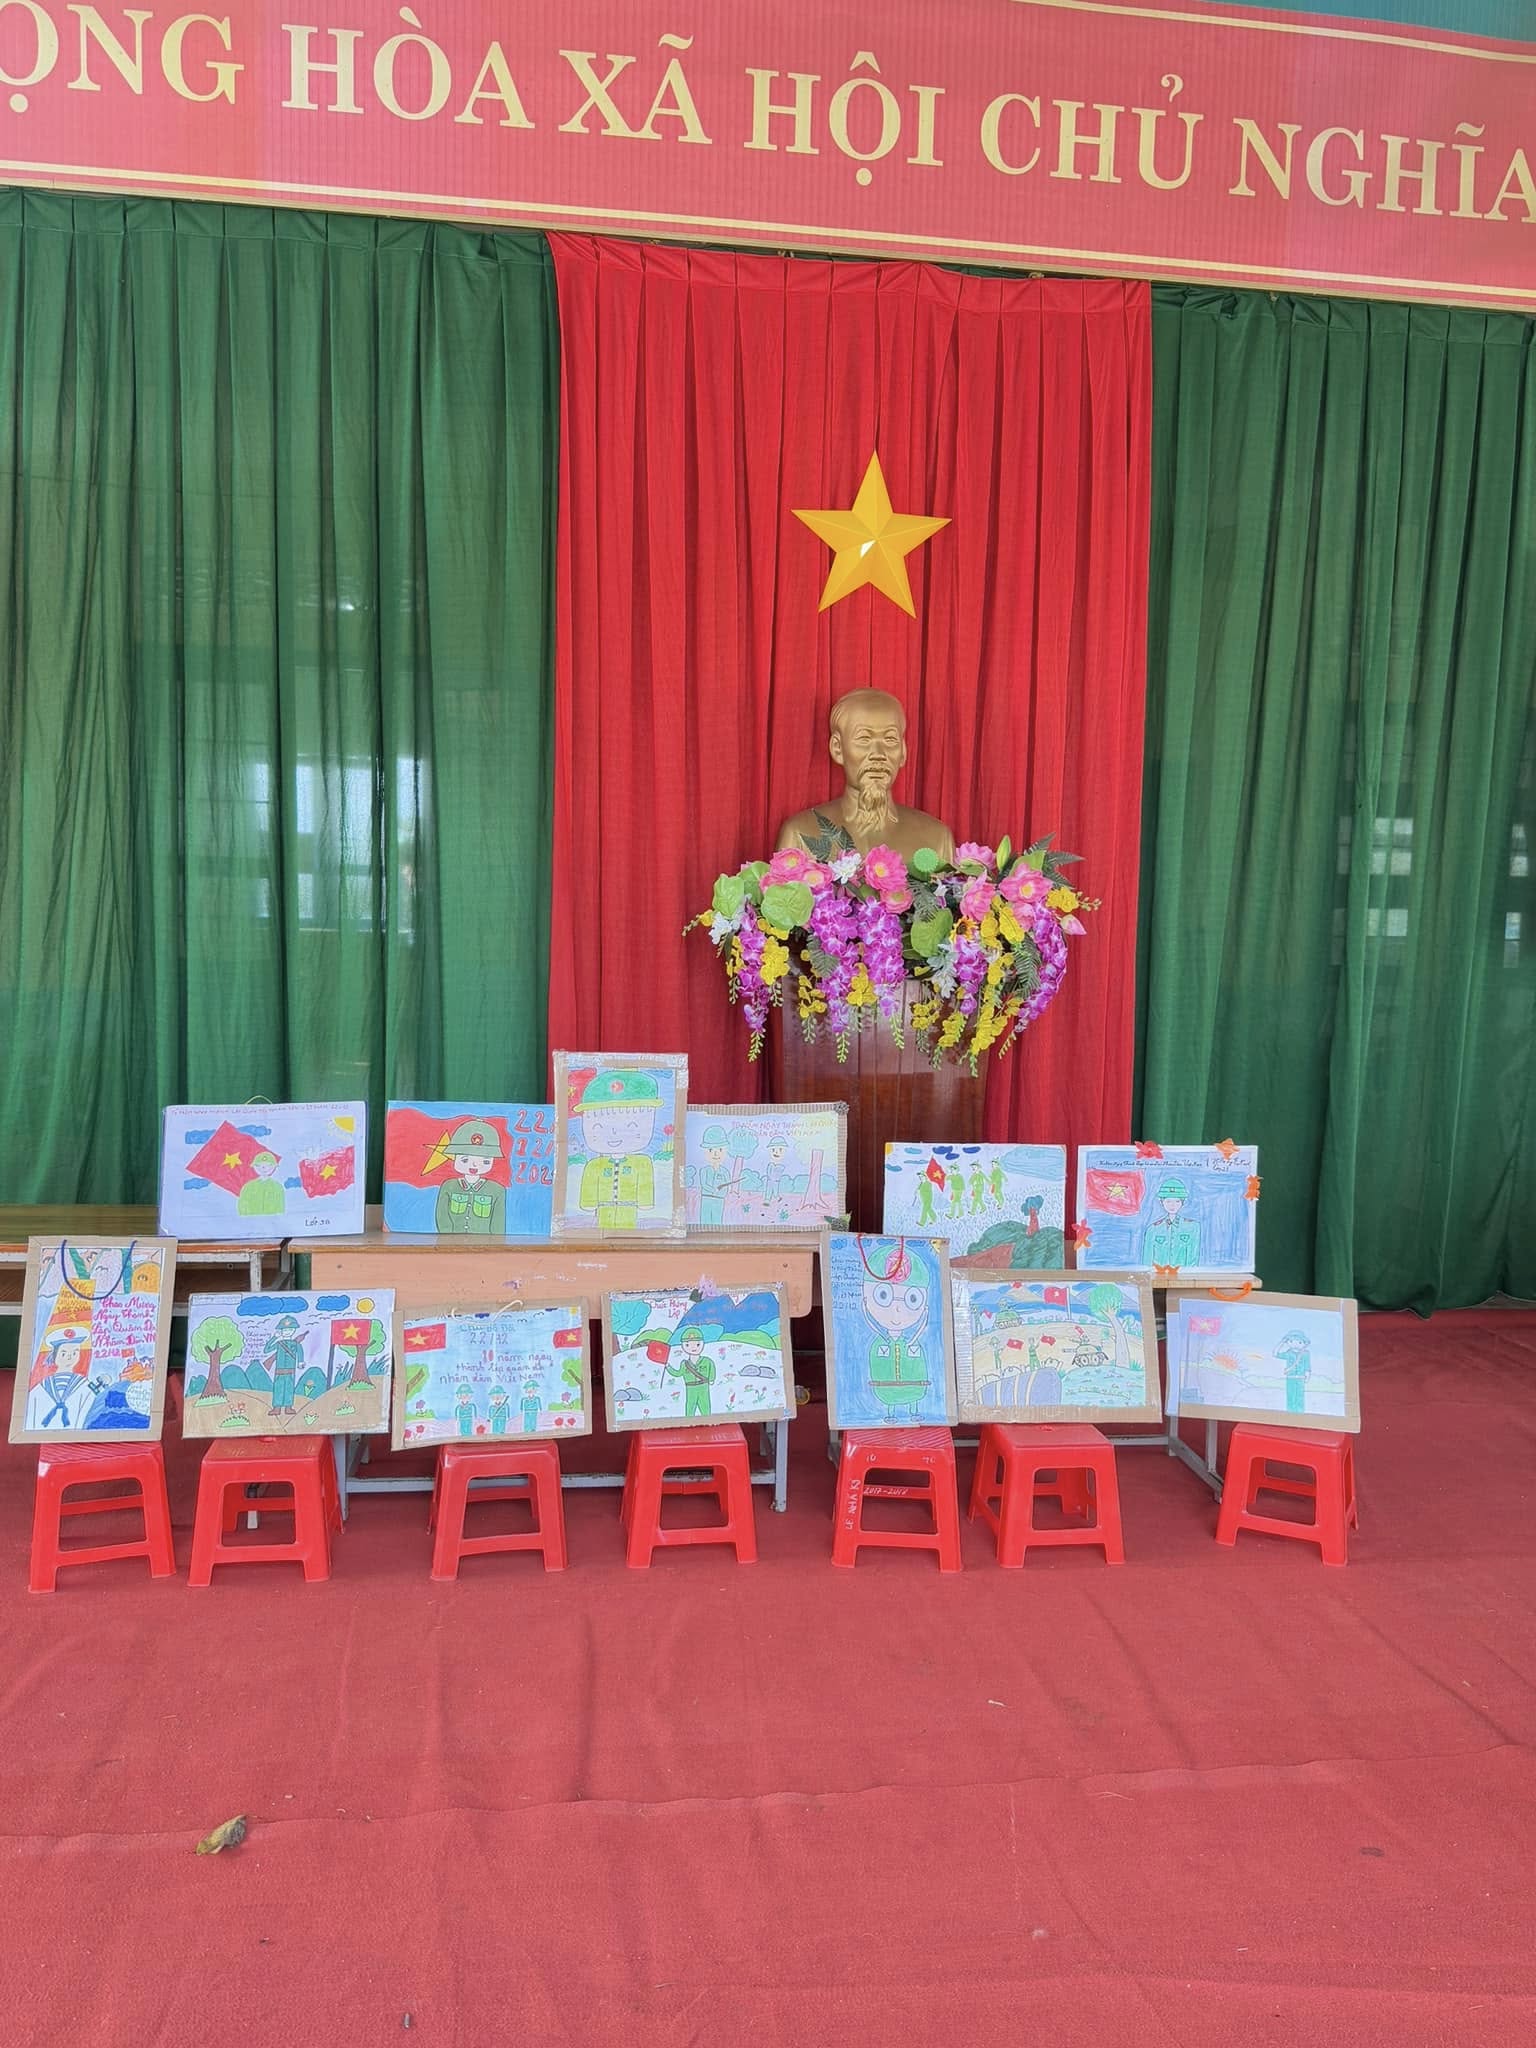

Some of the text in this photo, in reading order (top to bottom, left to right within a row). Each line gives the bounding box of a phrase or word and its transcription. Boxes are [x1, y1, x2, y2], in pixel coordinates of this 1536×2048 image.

[281, 7, 535, 130] HÒA
[558, 33, 713, 146] XÃ
[743, 51, 946, 187] HỘI
[980, 73, 1204, 191] CHỦ
[1228, 121, 1536, 224] NGHĨA
[515, 1162, 555, 1186] 202
